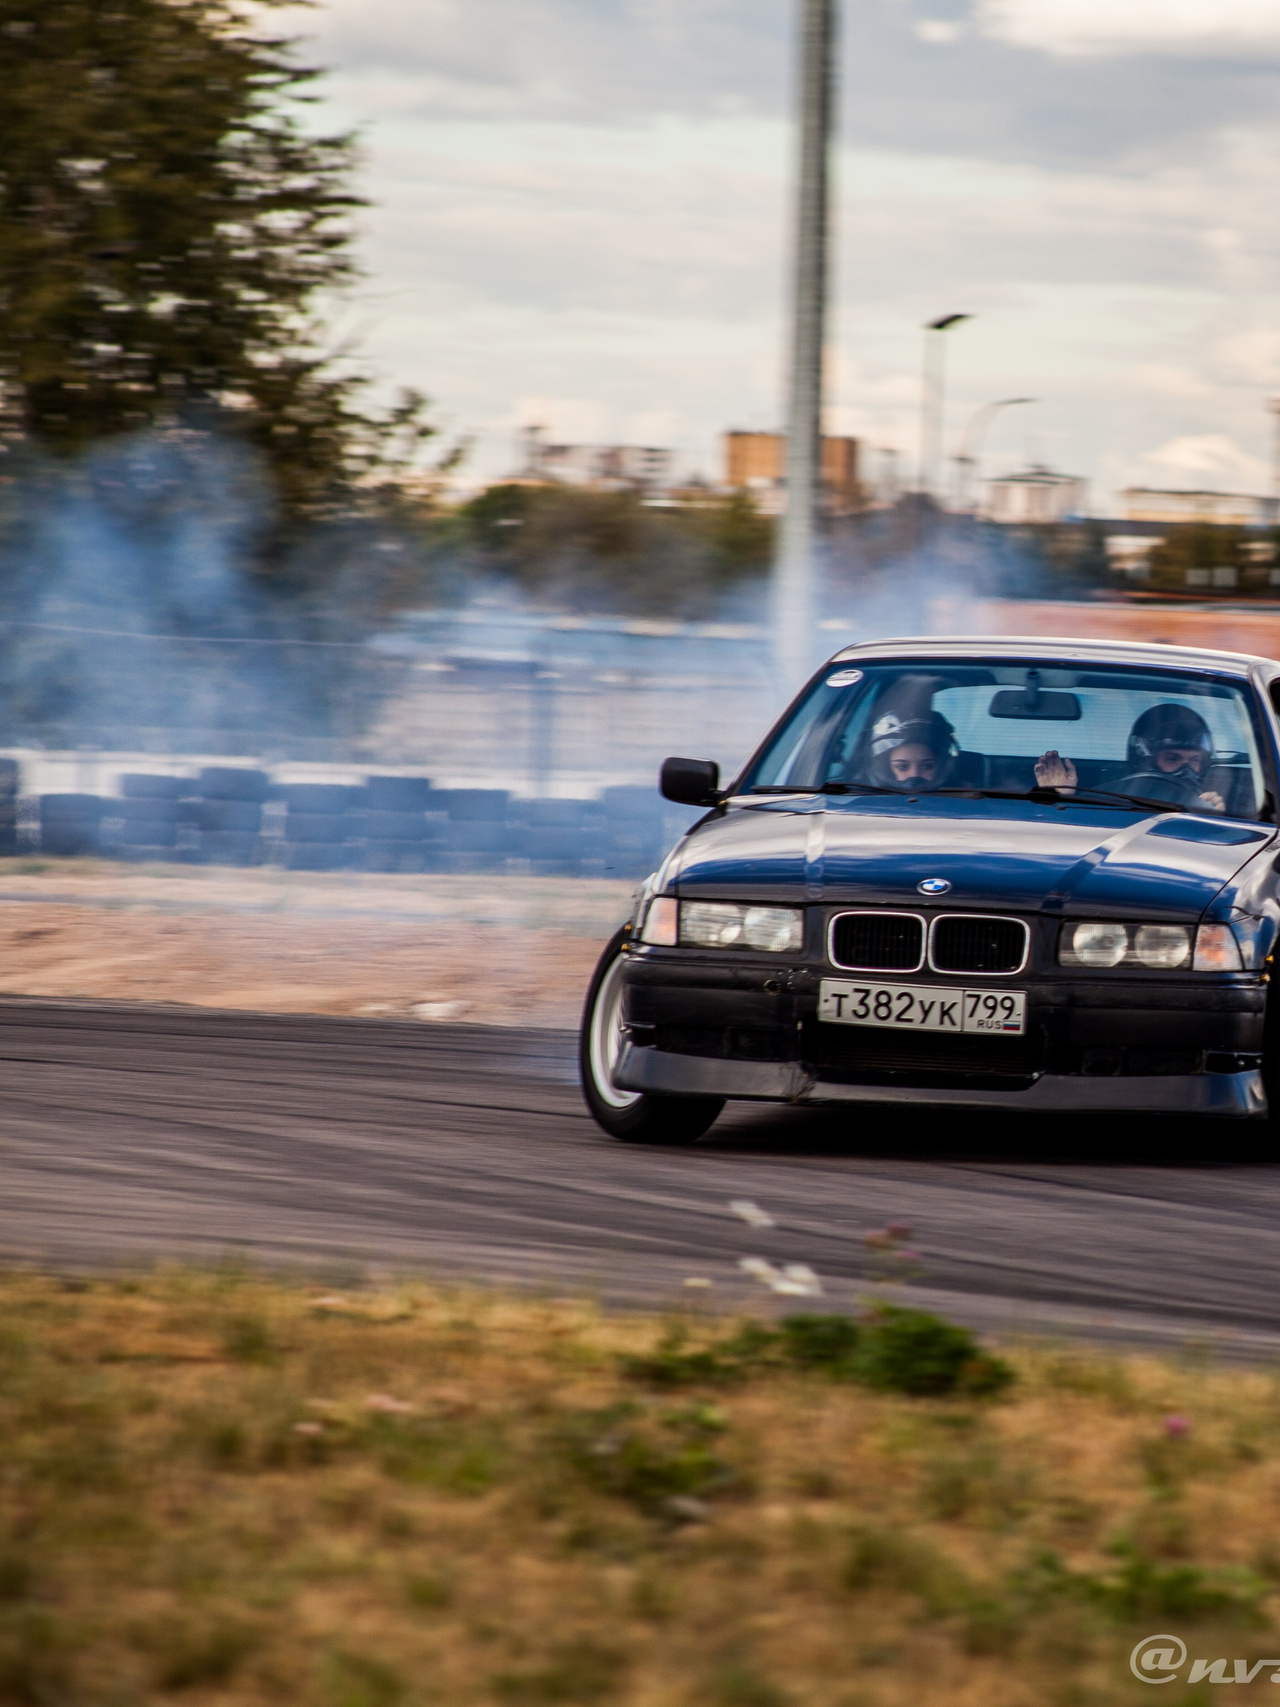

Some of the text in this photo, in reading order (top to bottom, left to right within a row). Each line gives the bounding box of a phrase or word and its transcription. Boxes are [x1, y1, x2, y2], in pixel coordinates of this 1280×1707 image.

[831, 988, 1015, 1026] Т382УК 799
[977, 1019, 1002, 1030] RUS
